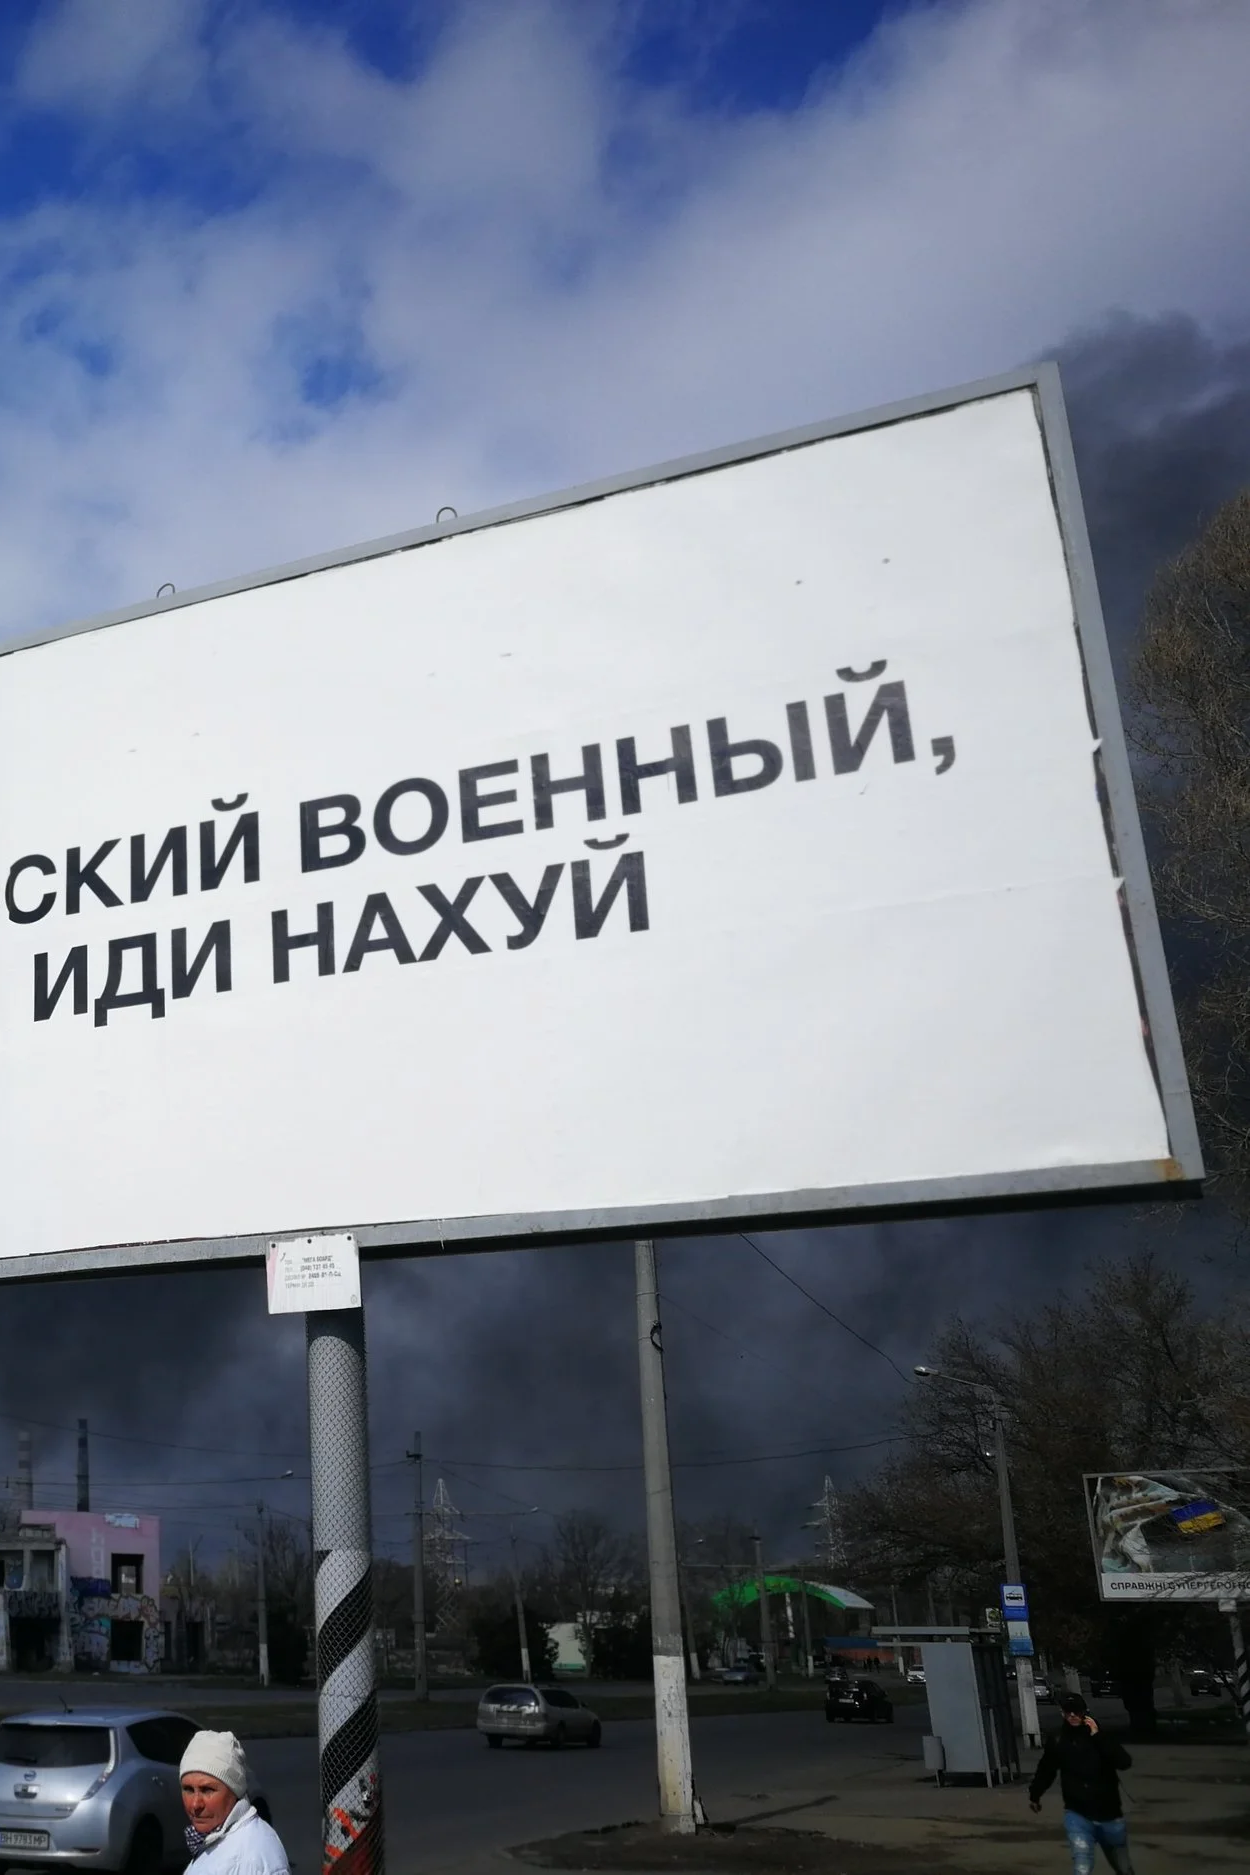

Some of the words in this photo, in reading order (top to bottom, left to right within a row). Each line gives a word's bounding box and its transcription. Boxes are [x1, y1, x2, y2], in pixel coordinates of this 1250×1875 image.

[299, 659, 956, 874] ВОЕННЫЙ,
[33, 919, 232, 1028] ИДИ
[271, 833, 650, 984] НАХУЙ
[1110, 1581, 1166, 1590] СПРАВЖНІ
